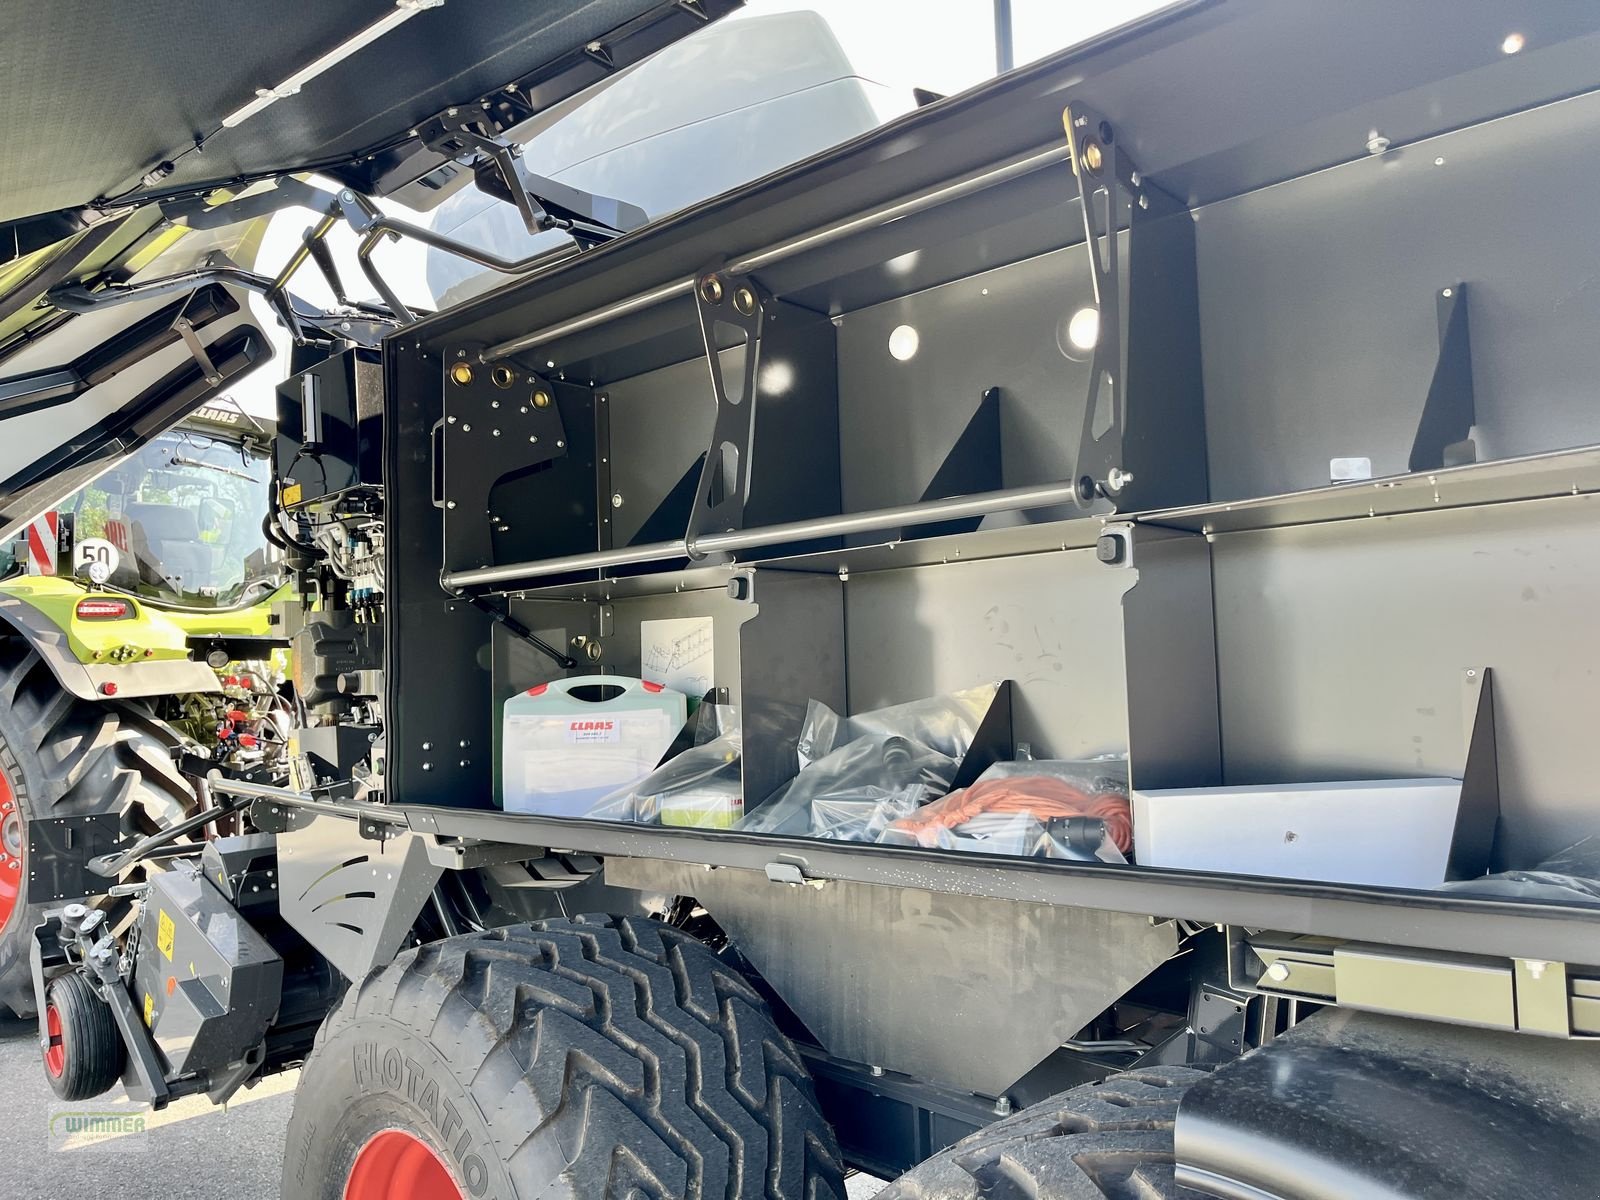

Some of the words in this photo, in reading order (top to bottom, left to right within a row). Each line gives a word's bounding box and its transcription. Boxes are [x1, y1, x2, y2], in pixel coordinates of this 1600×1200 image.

[82, 546, 110, 567] 50
[570, 721, 614, 730] CLAAS
[353, 1041, 496, 1200] FLOTATIO
